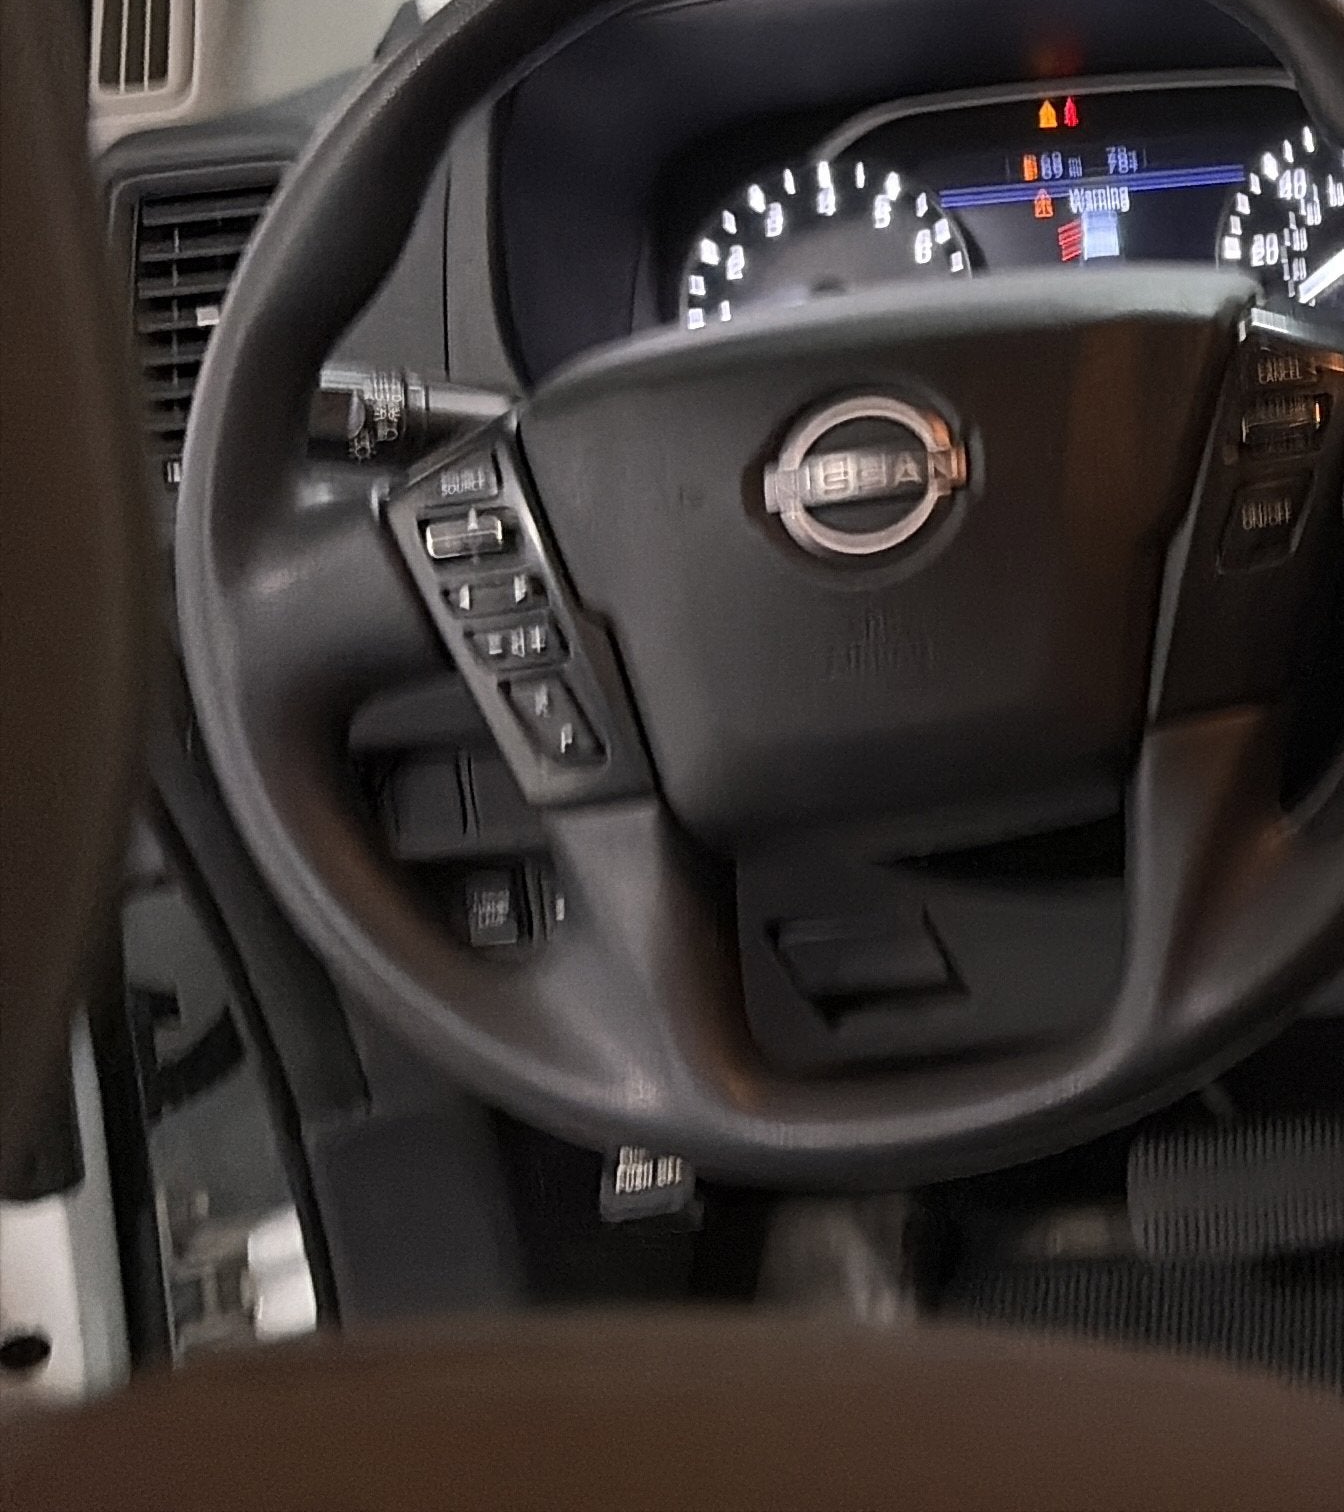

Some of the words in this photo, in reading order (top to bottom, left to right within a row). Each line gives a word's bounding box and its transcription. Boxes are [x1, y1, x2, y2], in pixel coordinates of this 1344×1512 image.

[1278, 168, 1307, 200] 40
[1069, 185, 1130, 214] Warning
[1250, 233, 1279, 267] 20
[1258, 357, 1302, 385] CANCEL
